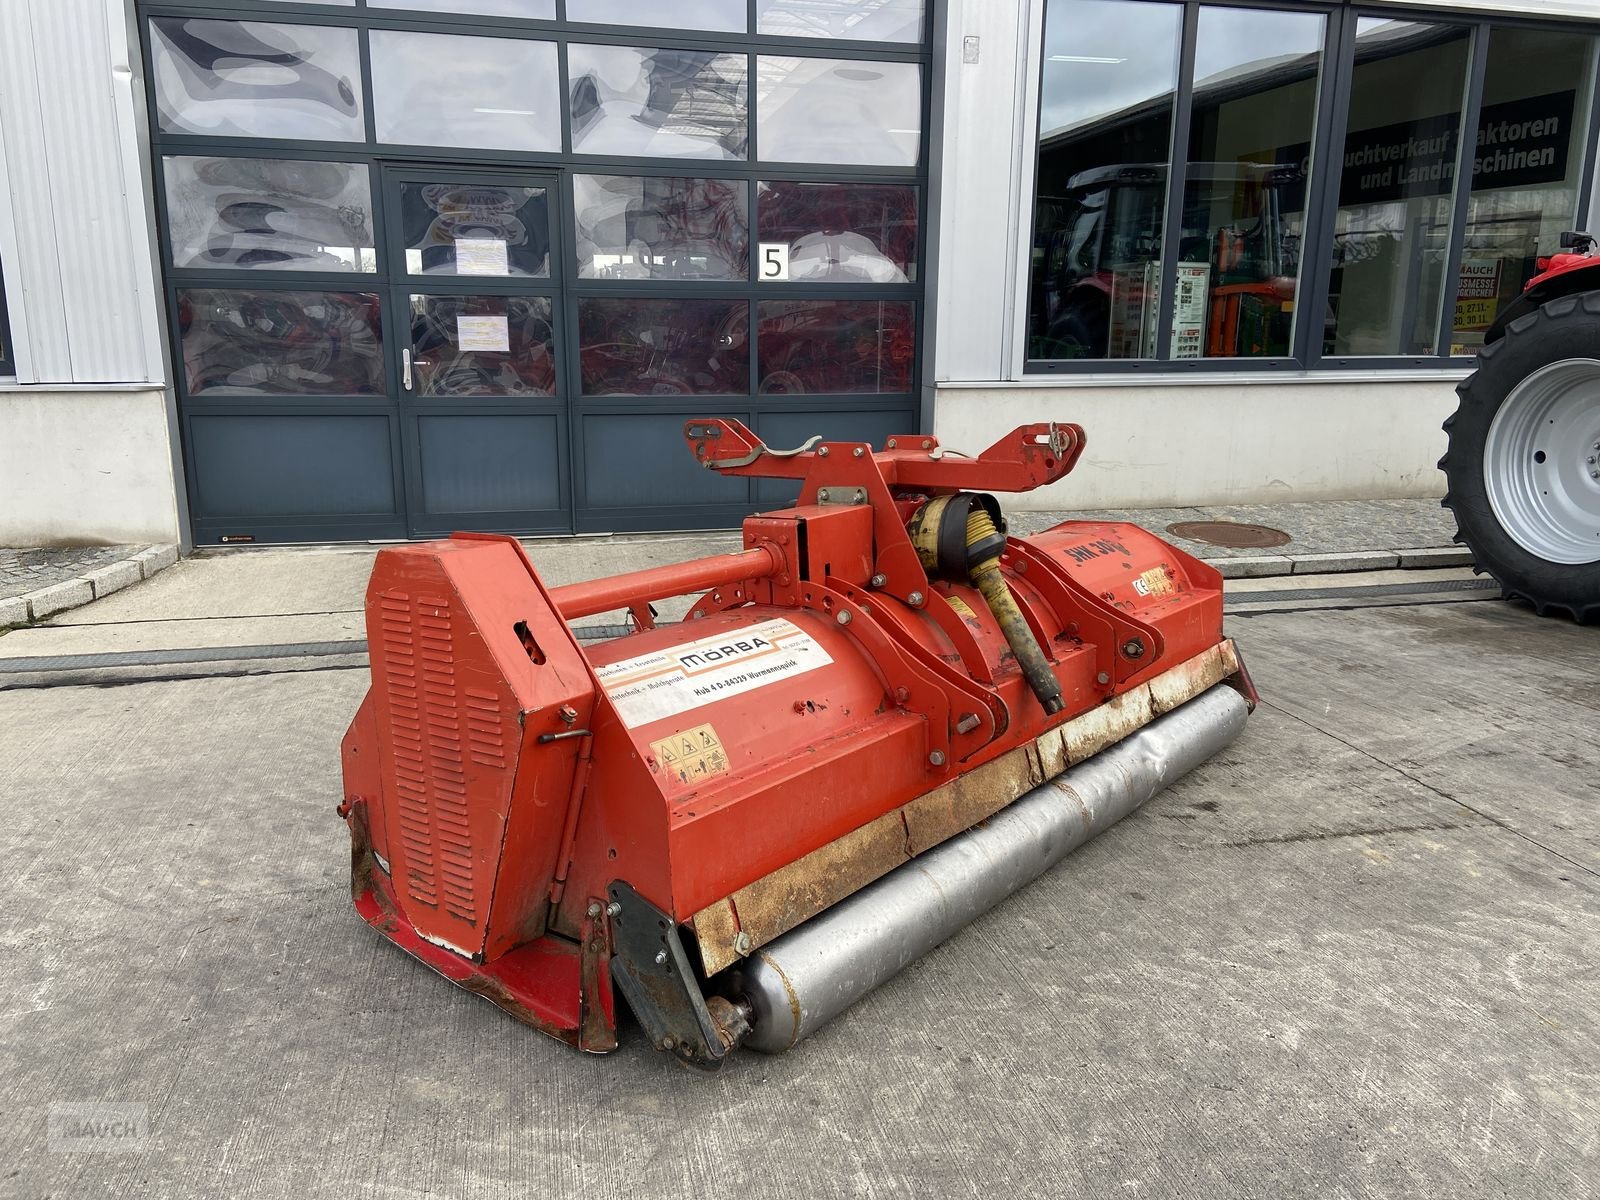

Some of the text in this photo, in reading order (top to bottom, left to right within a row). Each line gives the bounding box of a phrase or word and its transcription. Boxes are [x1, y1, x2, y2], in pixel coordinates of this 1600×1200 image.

[1301, 117, 1559, 177] Guchtverkauf aktoren
[1360, 146, 1555, 190] und Landmschinen
[765, 249, 781, 277] 5
[1458, 278, 1495, 289] USMESSE
[693, 686, 711, 697] Hub
[716, 674, 747, 690] D-84329
